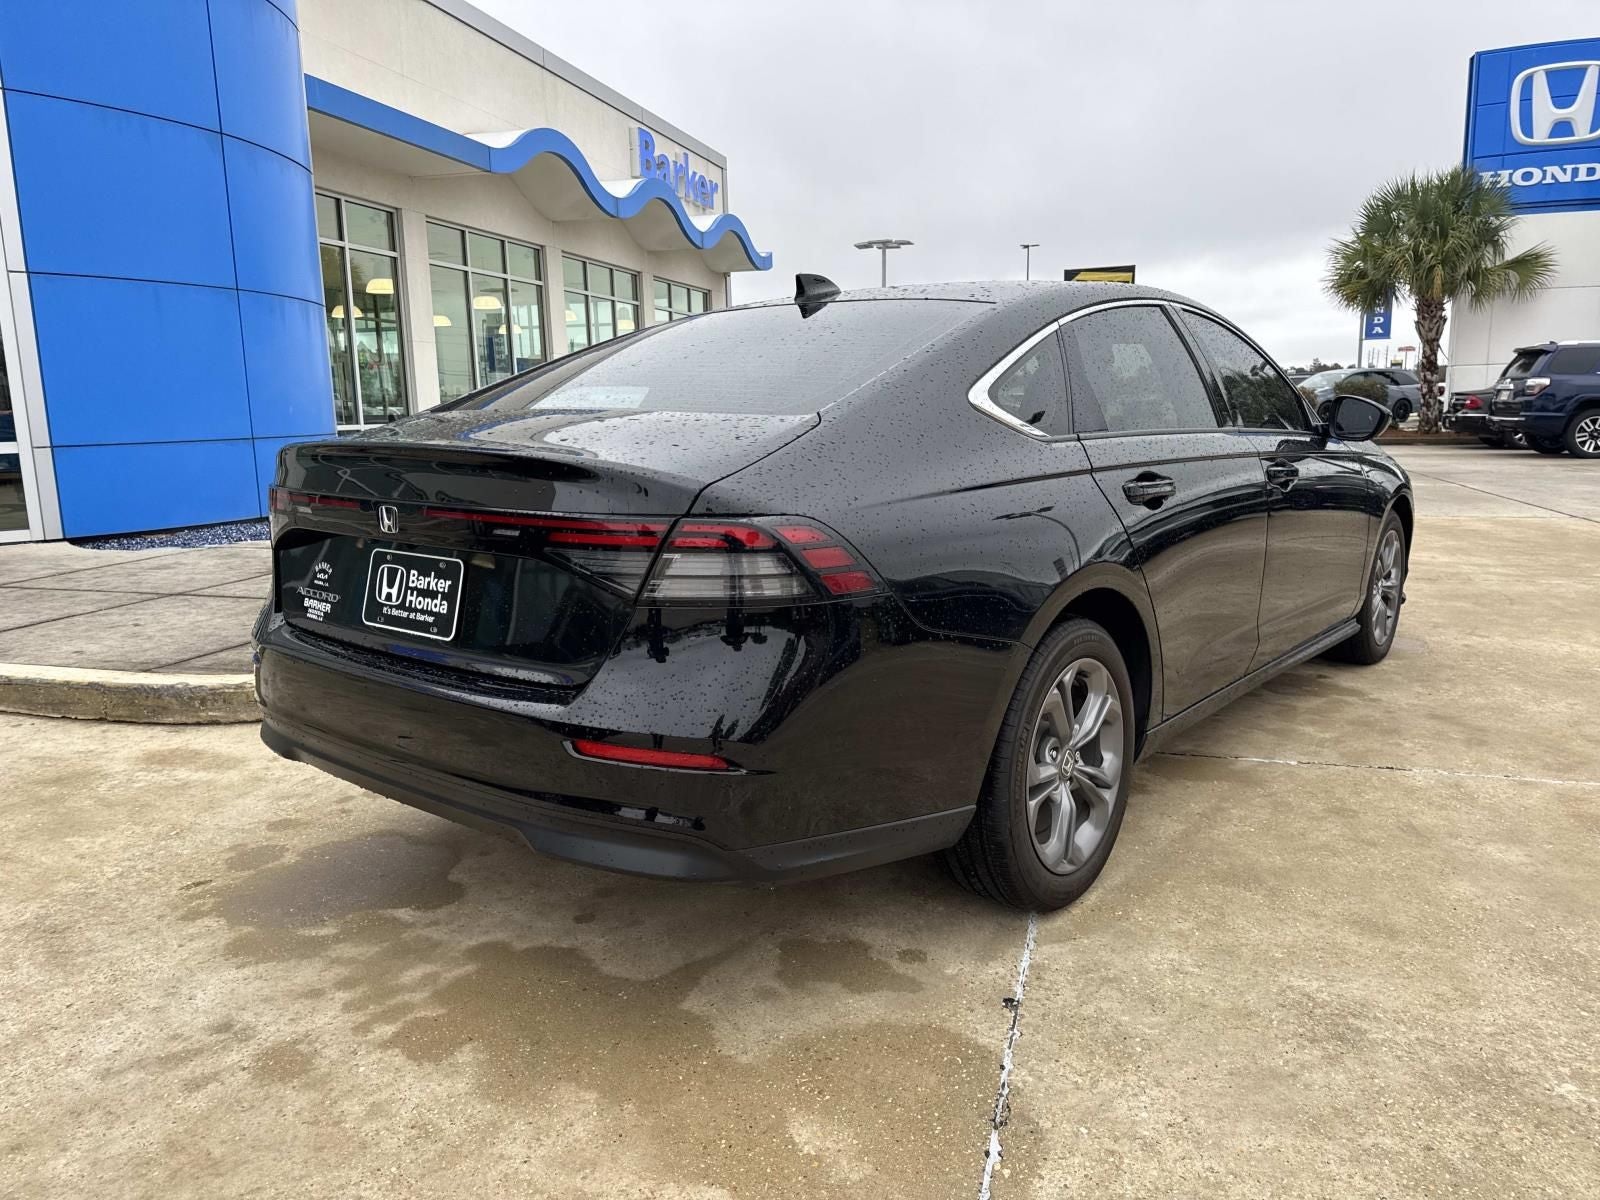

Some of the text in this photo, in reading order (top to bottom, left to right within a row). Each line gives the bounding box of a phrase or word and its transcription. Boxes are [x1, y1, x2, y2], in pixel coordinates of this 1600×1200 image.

[633, 127, 720, 210] Barker
[408, 569, 452, 593] Barker
[295, 586, 340, 603] ACCORD
[405, 589, 448, 614] Honda
[303, 597, 332, 614] BARKER
[391, 607, 409, 618] Better
[408, 611, 416, 620] at
[415, 612, 436, 623] Barker
